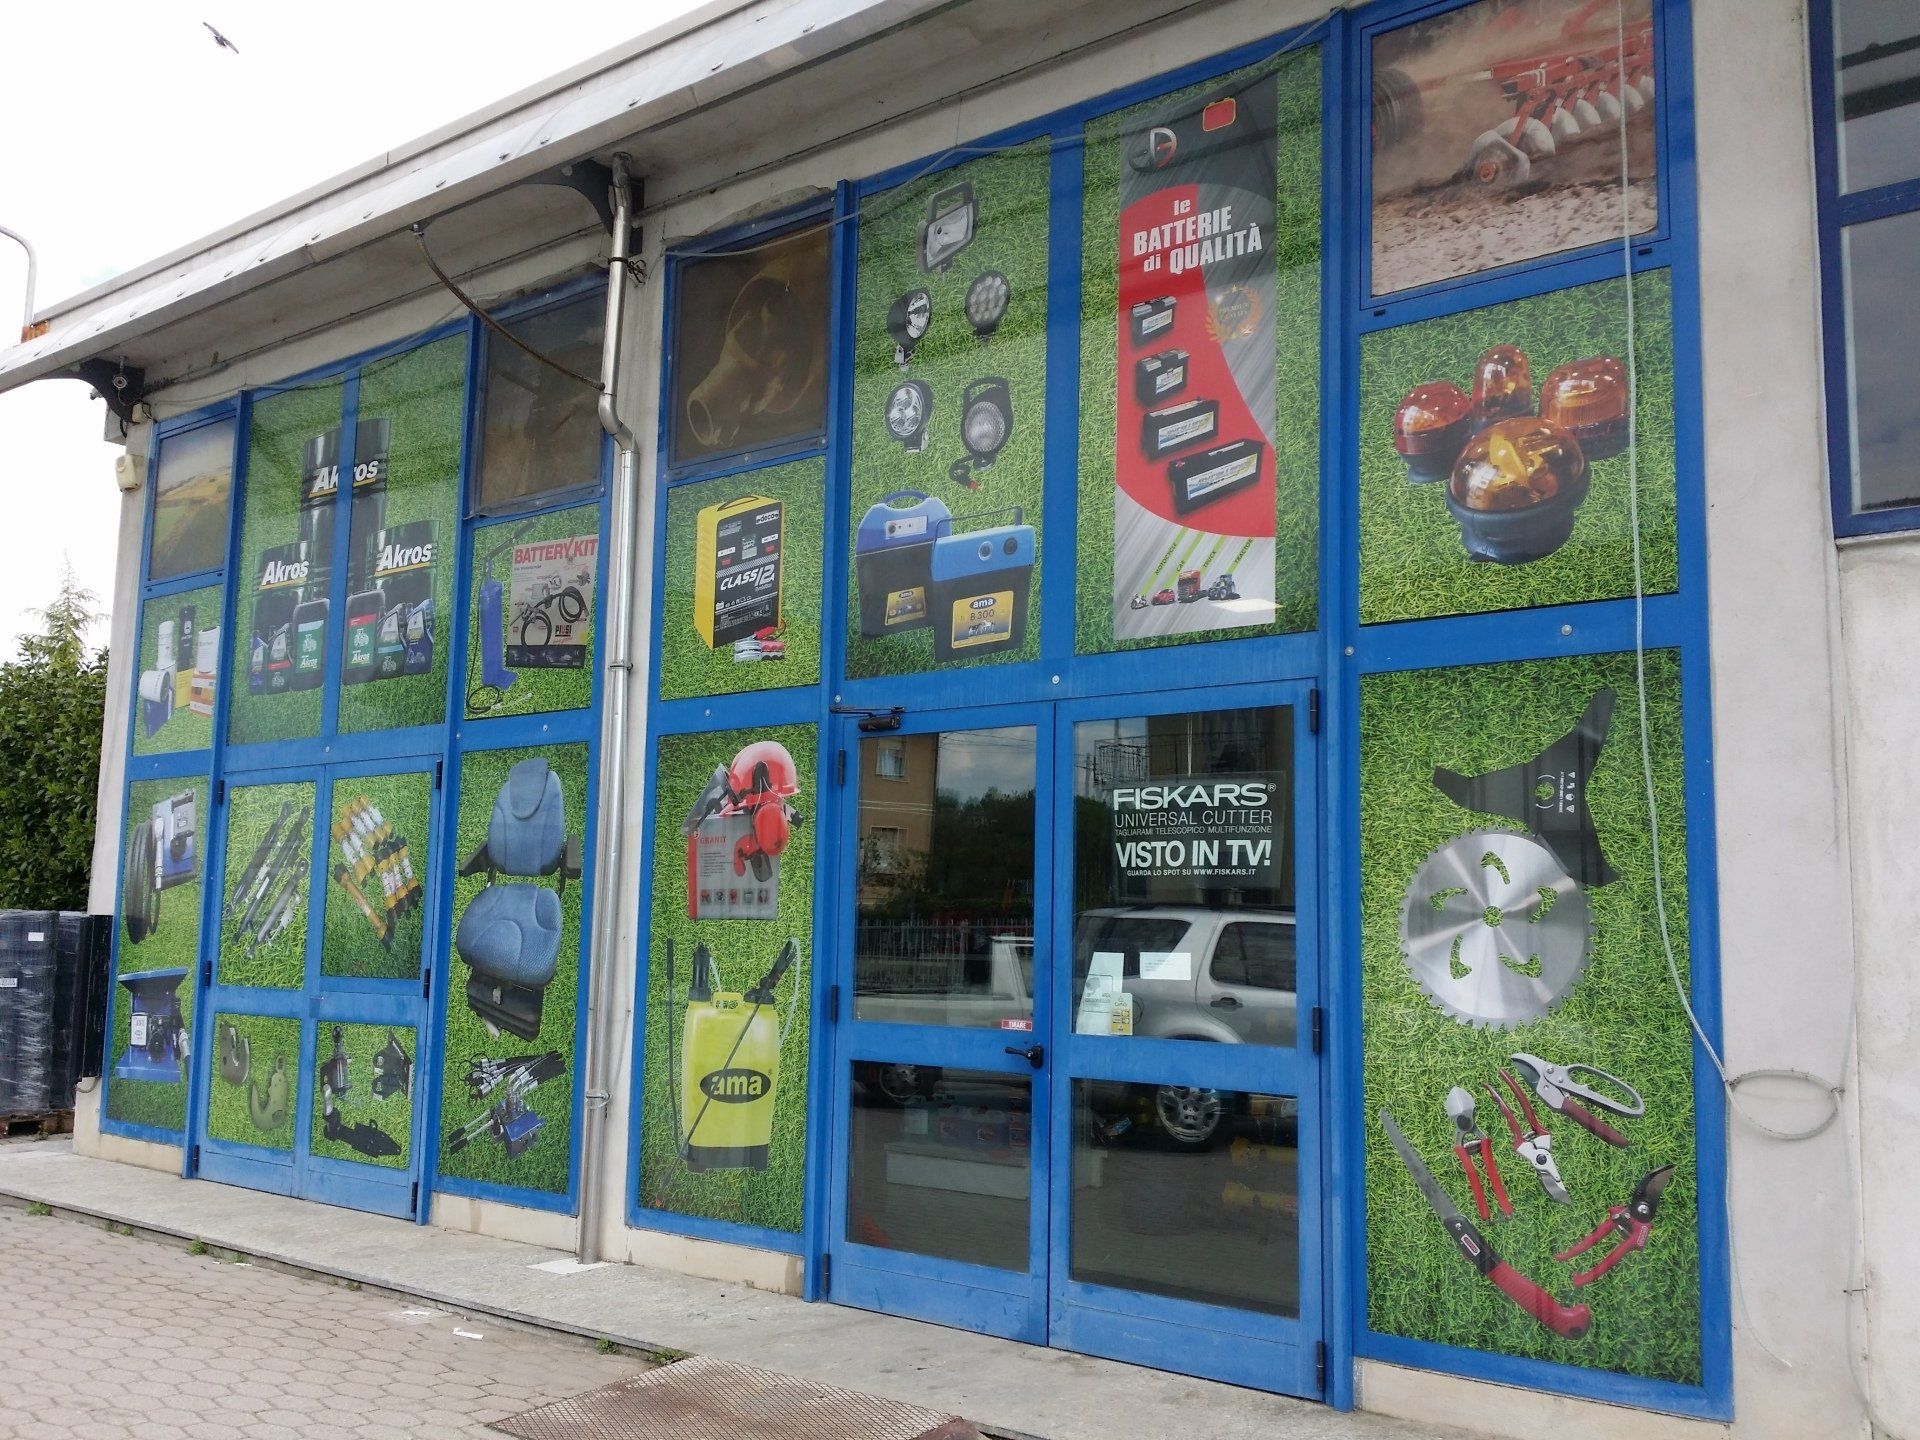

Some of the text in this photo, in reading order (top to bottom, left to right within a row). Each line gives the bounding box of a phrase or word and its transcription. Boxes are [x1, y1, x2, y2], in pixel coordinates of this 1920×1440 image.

[1173, 199, 1191, 216] le
[1133, 205, 1232, 257] BATTERIE
[1143, 222, 1263, 275] di QUALITÀ
[379, 542, 432, 571] Akros
[514, 538, 599, 564] BATTERY KIT
[1203, 550, 1217, 568] TRUCK
[261, 559, 309, 586] Akros
[720, 568, 759, 591] CLASS
[972, 598, 994, 608] ama
[555, 624, 572, 635] PIUSI
[1114, 809, 1273, 828] UNIVERSAL CUTTER
[1115, 825, 1273, 837] TAGLIARAMI TELESCOPICO MULTIFUNZIONE
[1115, 839, 1272, 868] VISTO IN TV!
[1126, 868, 1256, 877] GUARDA LO SPOT SU WWW.FISKARS.IT
[710, 1074, 763, 1096] ama
